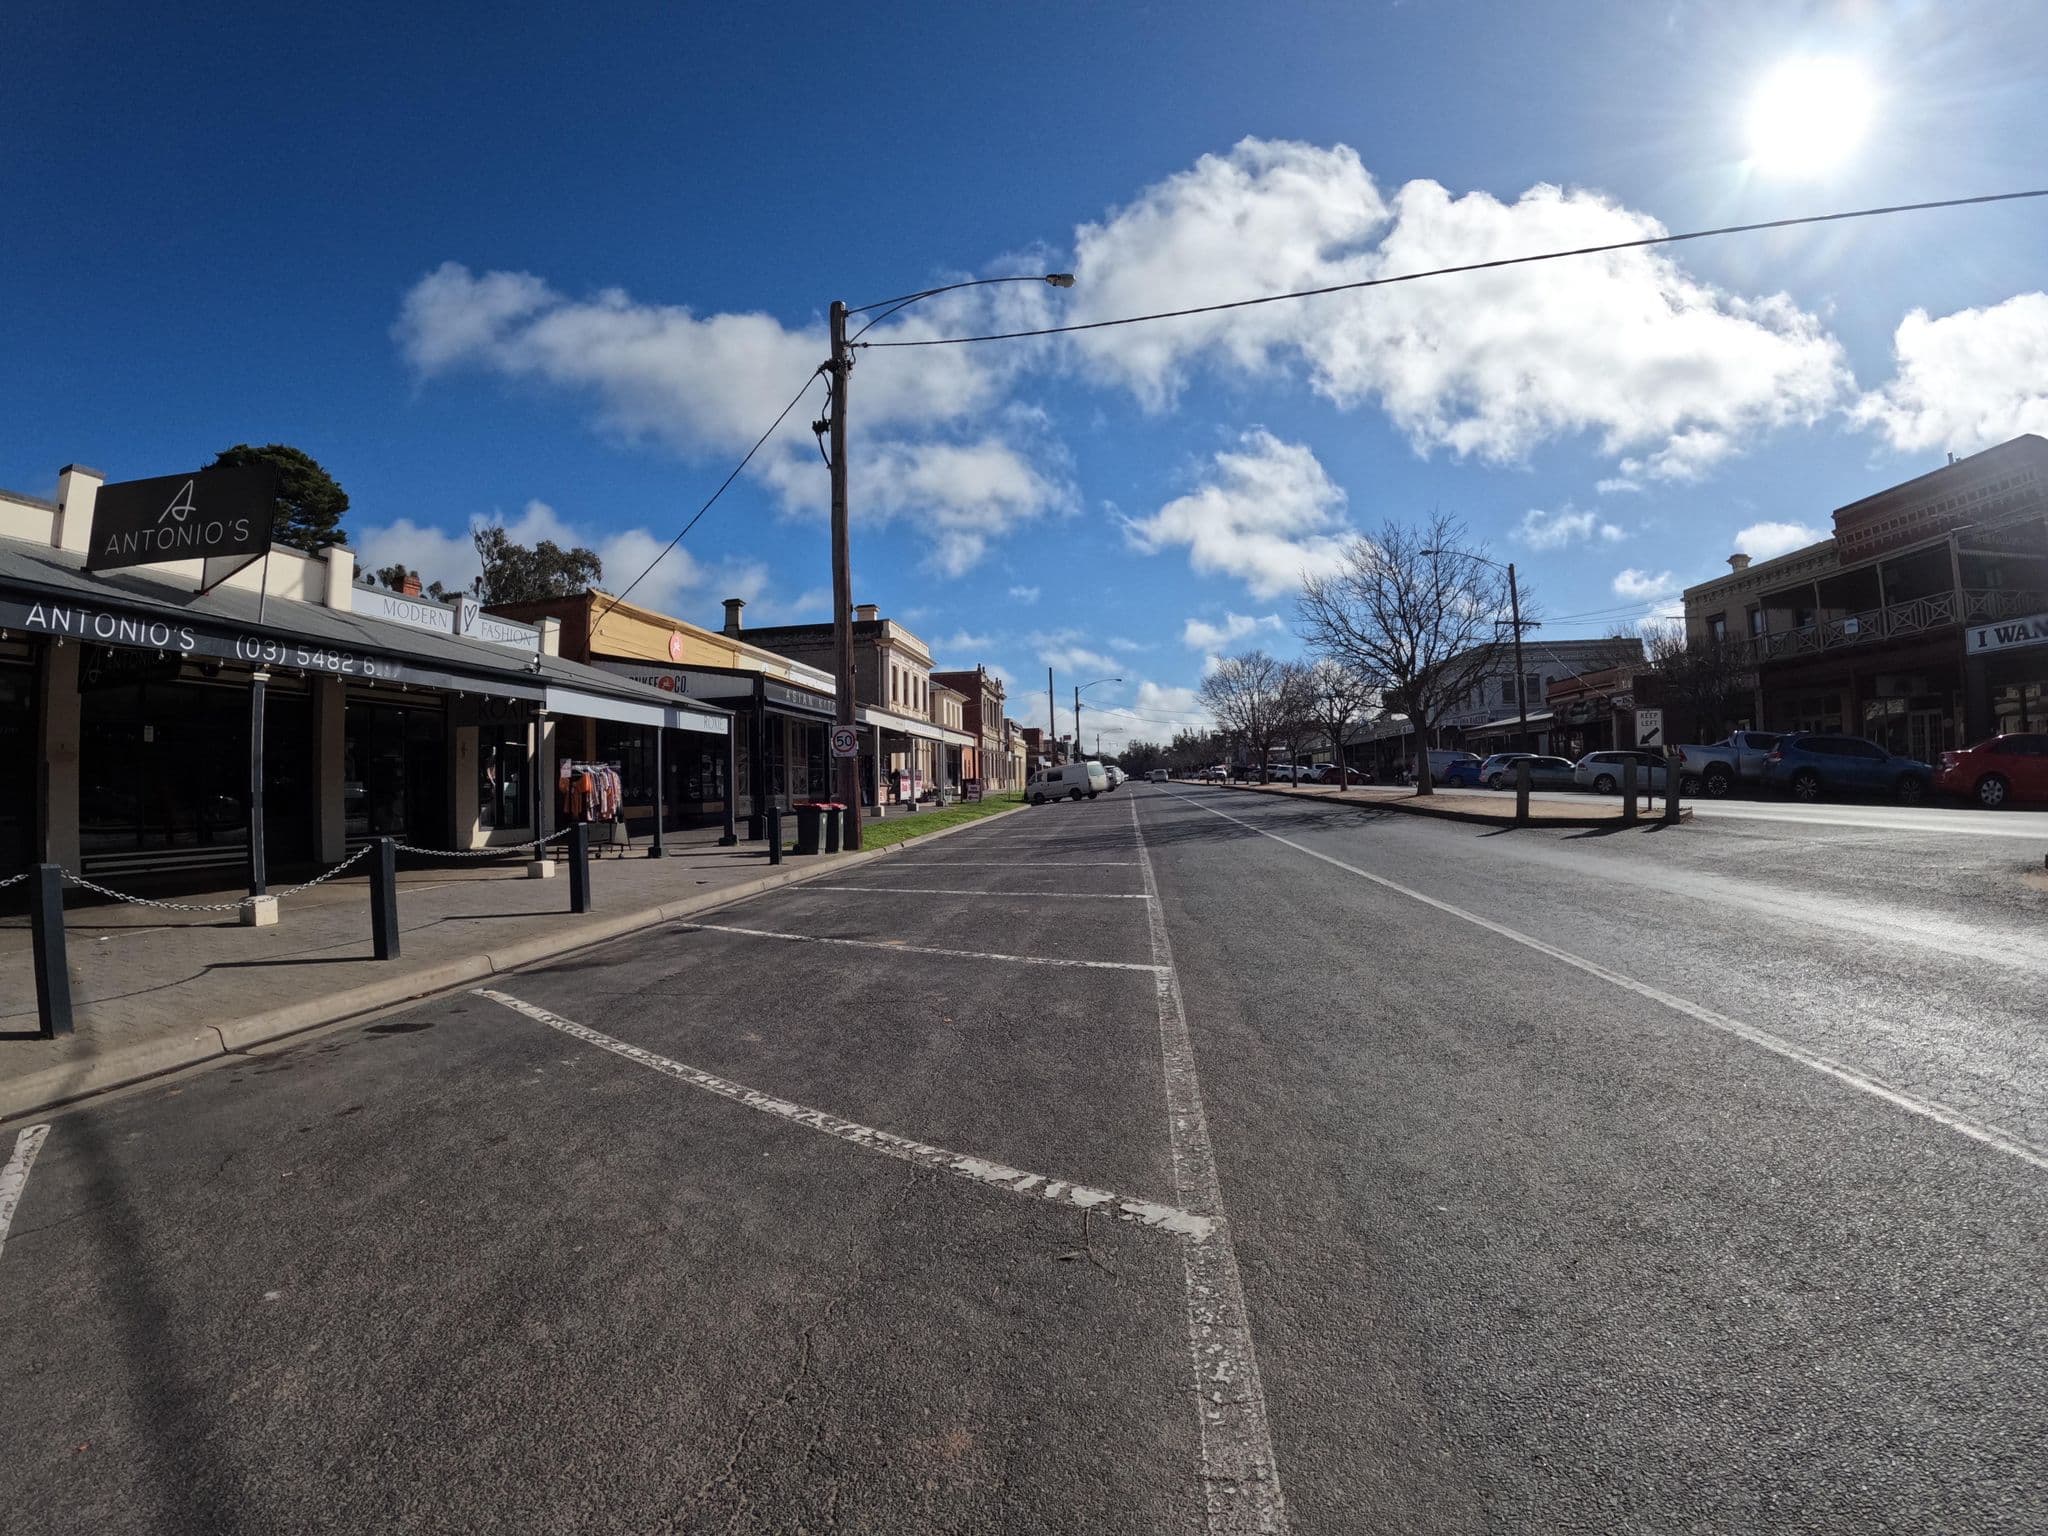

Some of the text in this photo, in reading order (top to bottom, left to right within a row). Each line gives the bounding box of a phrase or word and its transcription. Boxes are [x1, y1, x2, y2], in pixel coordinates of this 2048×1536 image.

[104, 518, 250, 556] ANTONIO'S
[383, 597, 532, 648] MODERN FASHION
[25, 601, 196, 650] ANTONIO'S
[235, 633, 287, 665] (03)
[296, 645, 354, 673] 5482
[1977, 630, 1988, 648] I
[674, 675, 689, 693] CO.
[785, 688, 813, 706] ASIAN
[836, 735, 853, 747] 50
